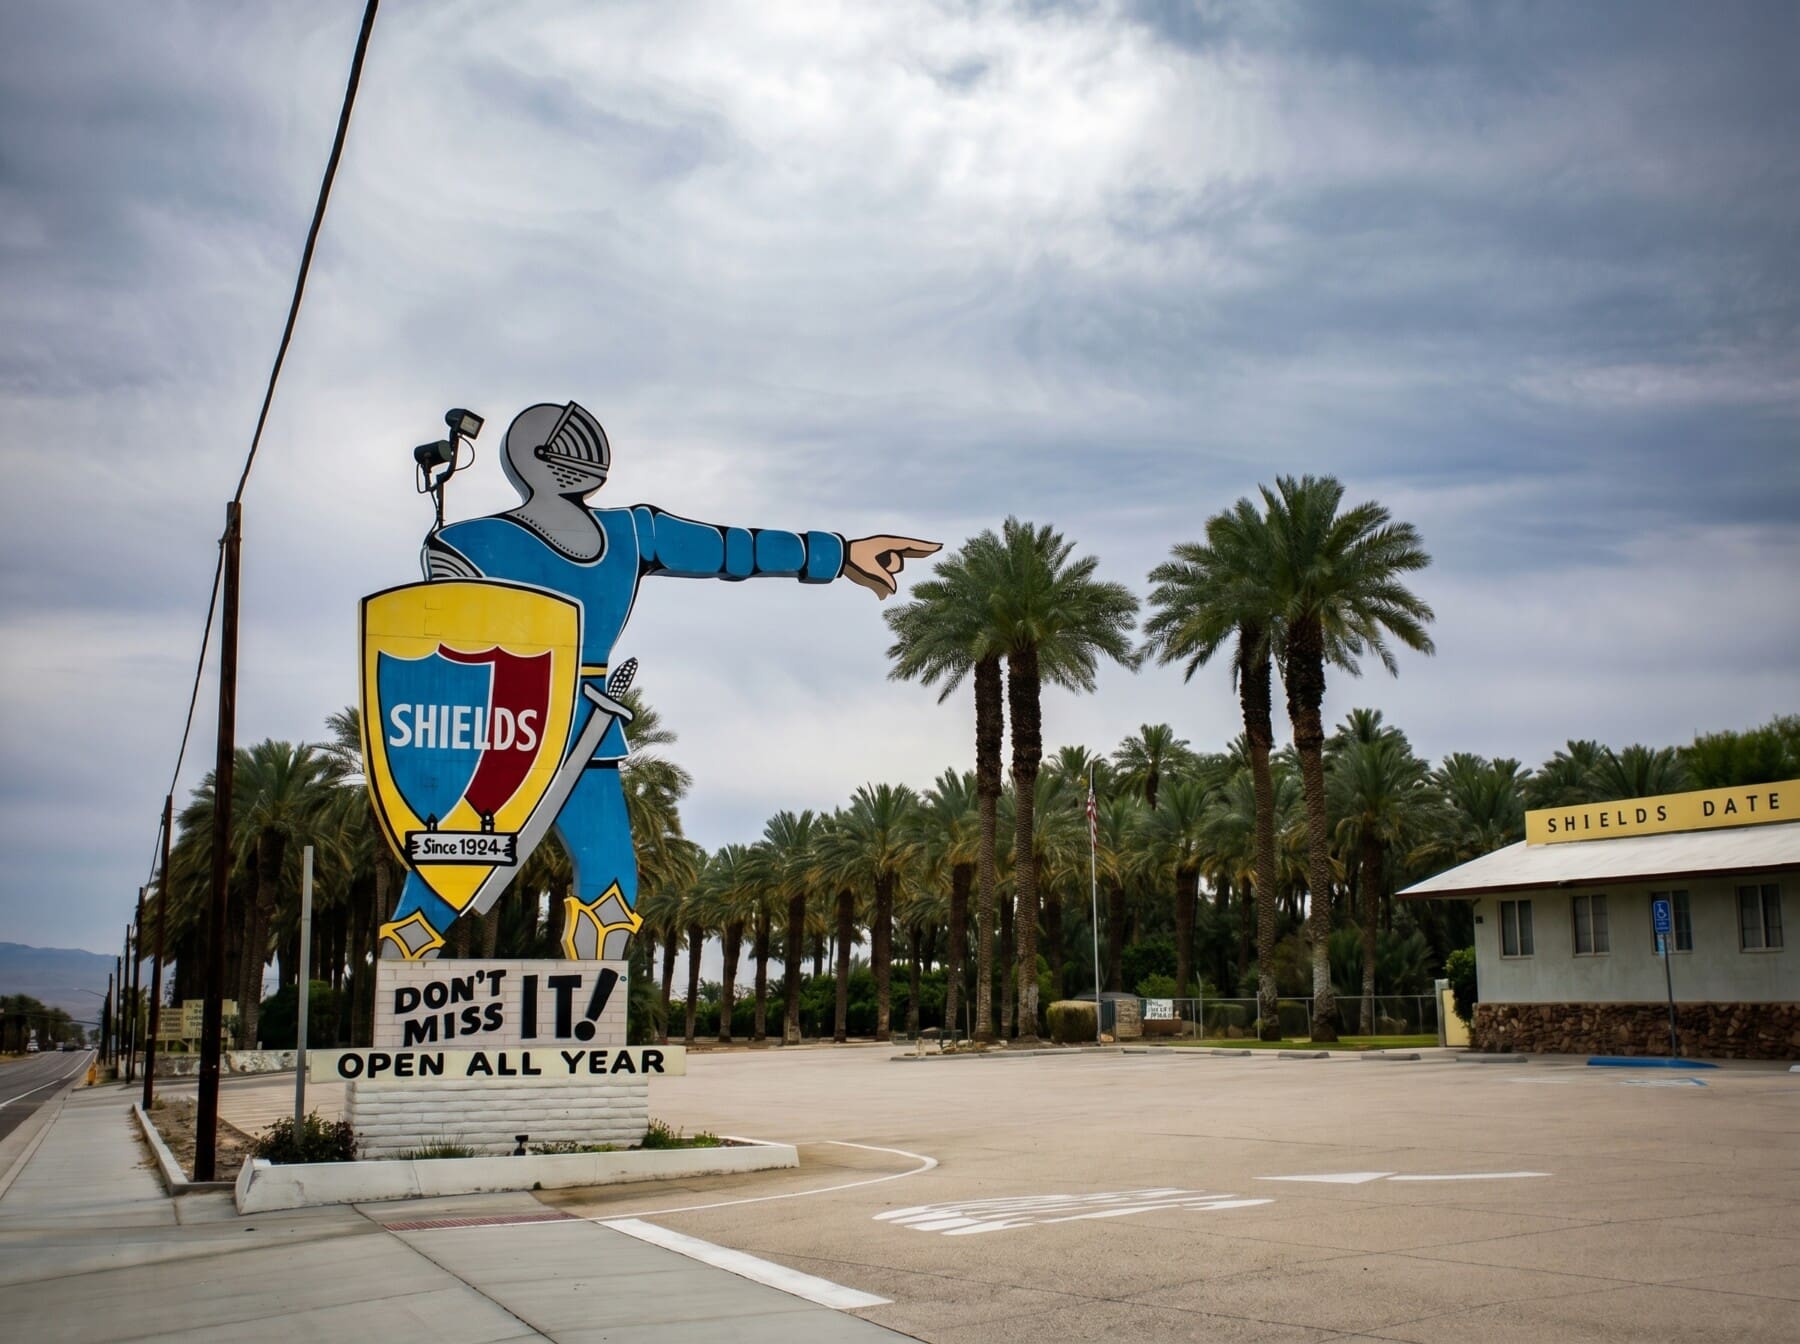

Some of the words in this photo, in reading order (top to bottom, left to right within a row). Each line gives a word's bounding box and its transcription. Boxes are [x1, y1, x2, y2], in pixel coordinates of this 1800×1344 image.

[389, 703, 537, 751] SHIELDS
[1547, 805, 1667, 833] SHIELDS
[1703, 793, 1780, 817] DATE
[423, 838, 457, 855] Since
[459, 838, 501, 856] 1924
[394, 969, 507, 1015] DON'T
[521, 968, 619, 1041] IT!
[403, 1002, 504, 1047] MISS
[337, 1052, 444, 1079] OPEN
[466, 1051, 542, 1076] ALL
[561, 1049, 665, 1075] YEAR
